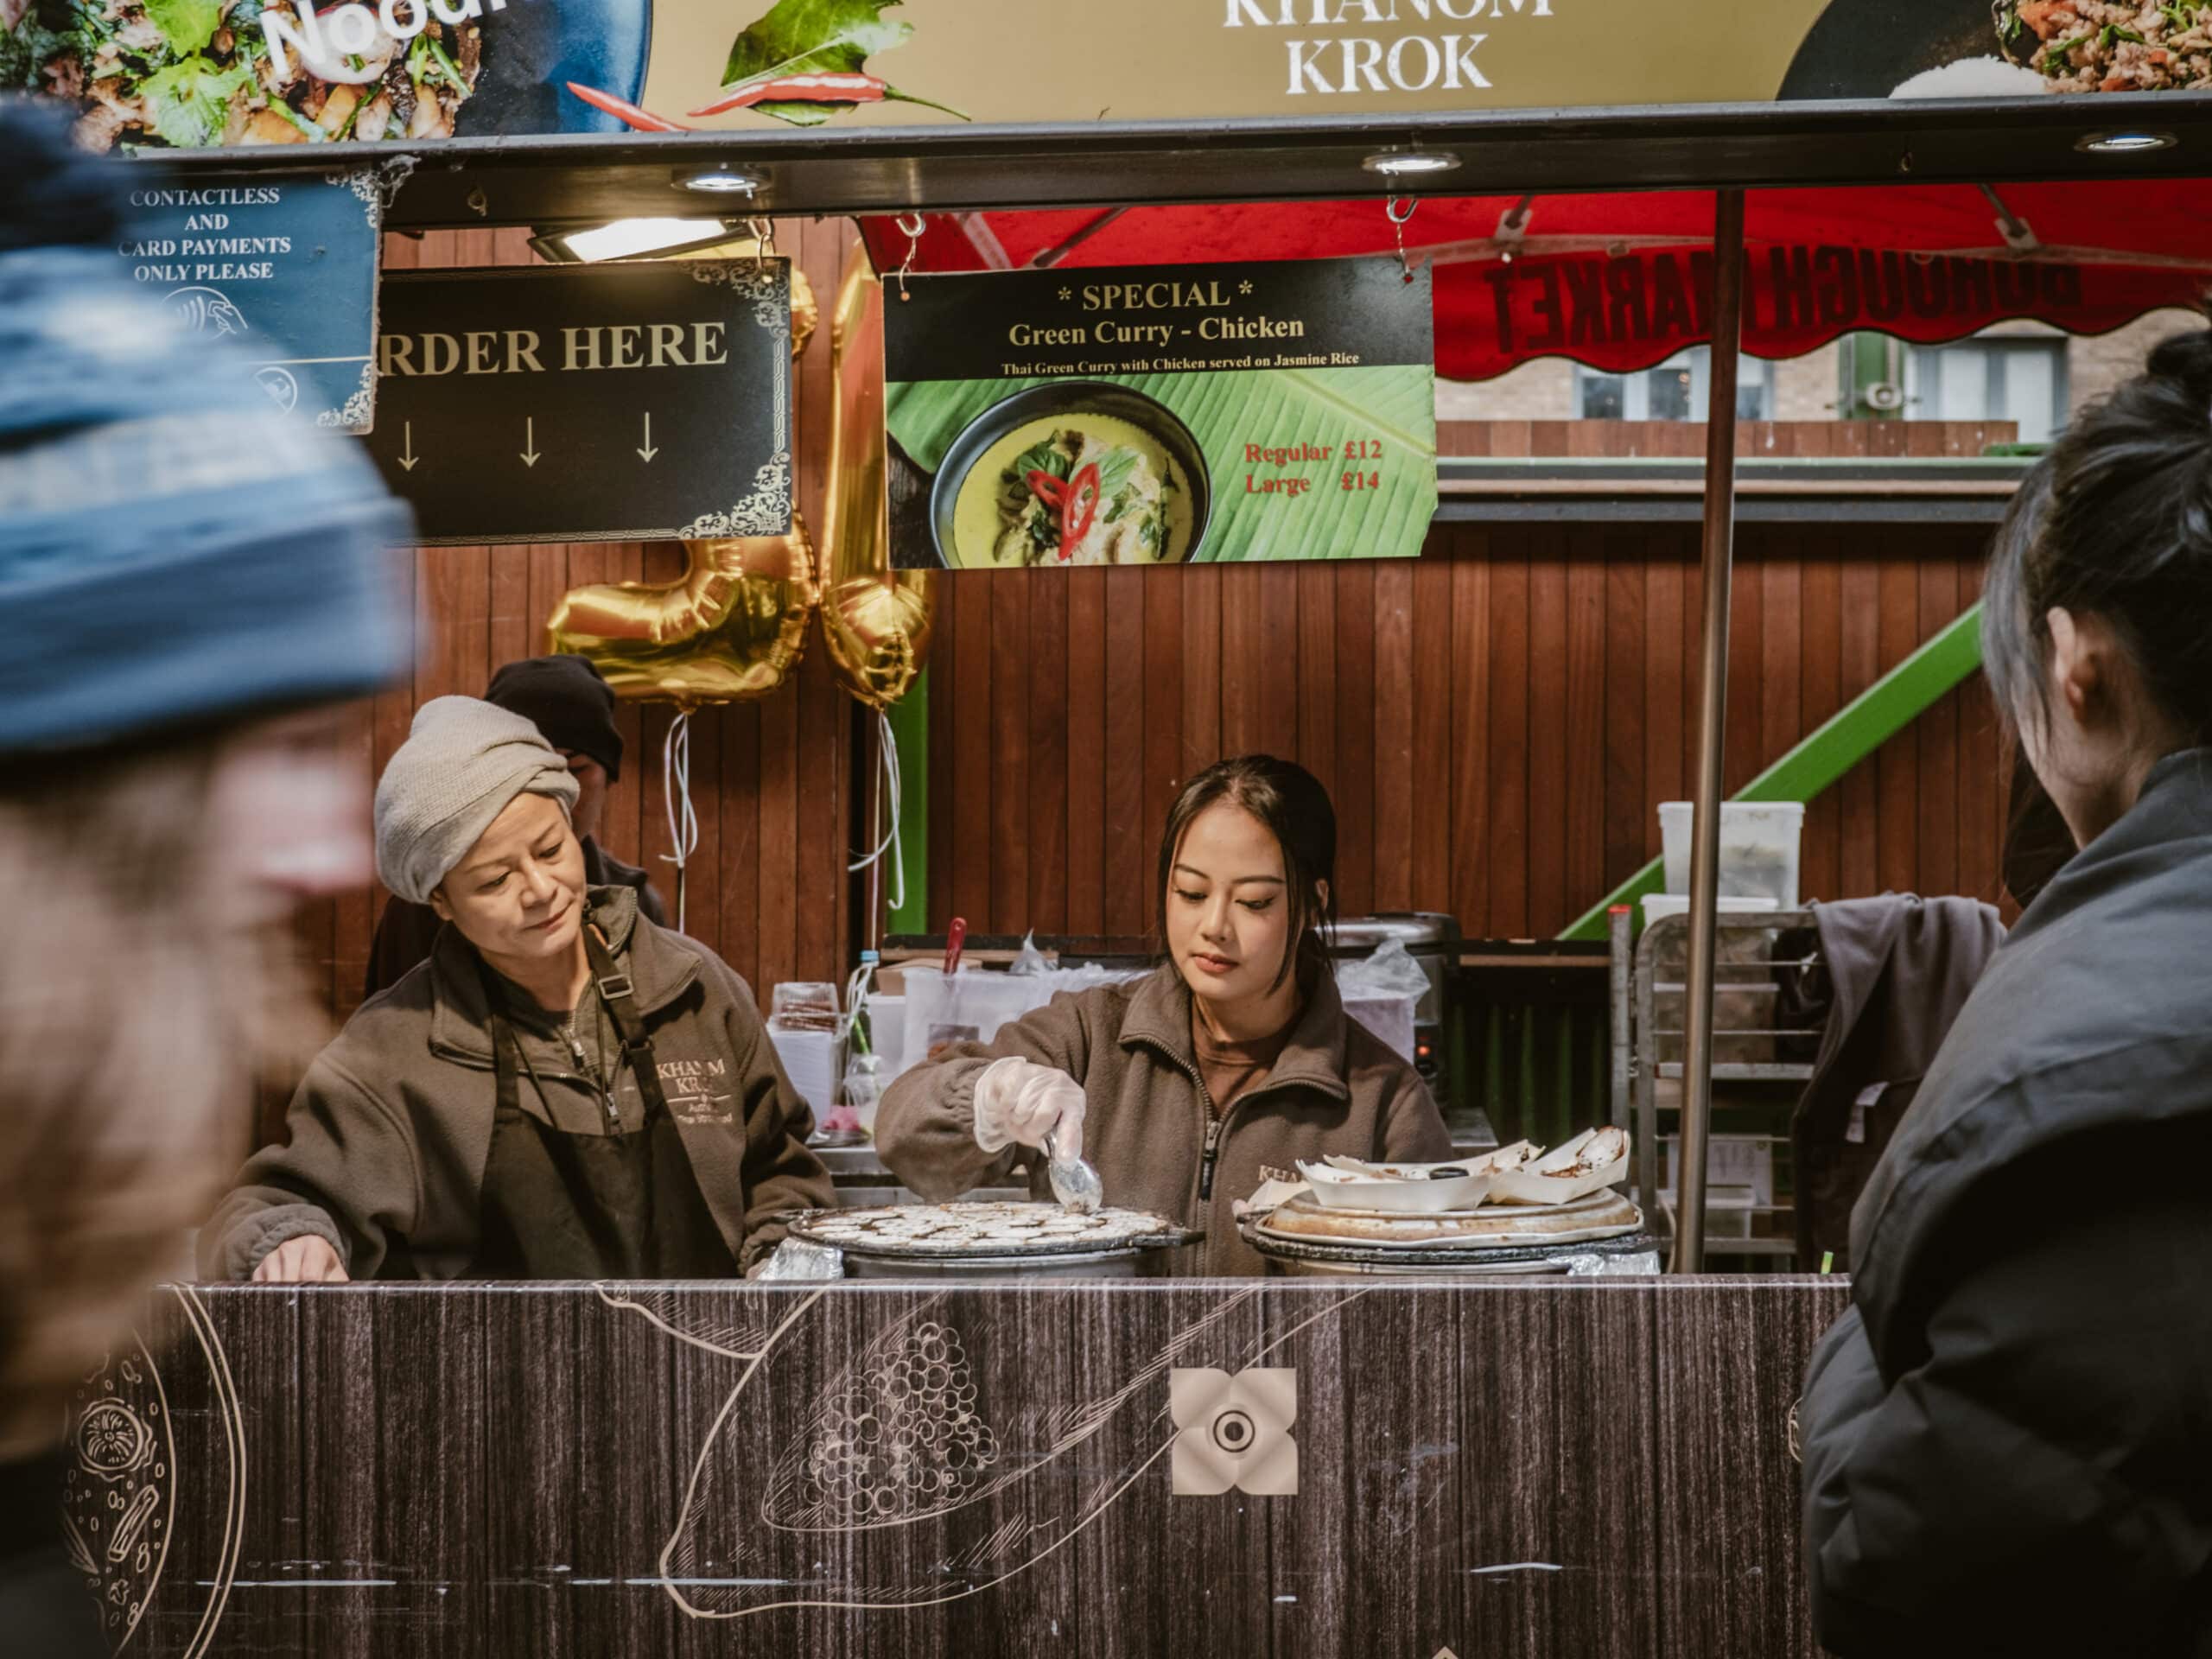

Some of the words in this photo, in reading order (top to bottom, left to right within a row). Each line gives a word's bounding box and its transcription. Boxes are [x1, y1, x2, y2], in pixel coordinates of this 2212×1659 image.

[260, 0, 506, 79] Noo
[1284, 34, 1493, 94] KROK
[130, 188, 280, 207] CONTACTLESS
[184, 214, 229, 231] AND
[118, 240, 176, 257] CARD
[181, 237, 291, 256] PAYMENTS
[134, 264, 191, 282] ONLY
[195, 262, 274, 280] PLEASE
[1082, 281, 1231, 311] SPECIAL
[1008, 323, 1086, 346] Green
[1094, 321, 1173, 347] Curry
[1198, 315, 1305, 340] Chicken
[380, 330, 546, 377] RDER
[559, 321, 728, 371] HERE
[1001, 363, 1032, 376] Thai
[1035, 361, 1075, 375] Green
[1077, 360, 1118, 376] Curry
[1122, 359, 1149, 372] with
[1153, 357, 1206, 371] Chicken
[1209, 355, 1251, 369] served
[1255, 358, 1272, 367] on
[1274, 353, 1327, 367] Jasmine
[1331, 352, 1360, 365] Rice
[1245, 442, 1332, 467] Regular
[1344, 439, 1382, 460] £12
[1245, 474, 1311, 498] Large
[1341, 471, 1380, 491] £14
